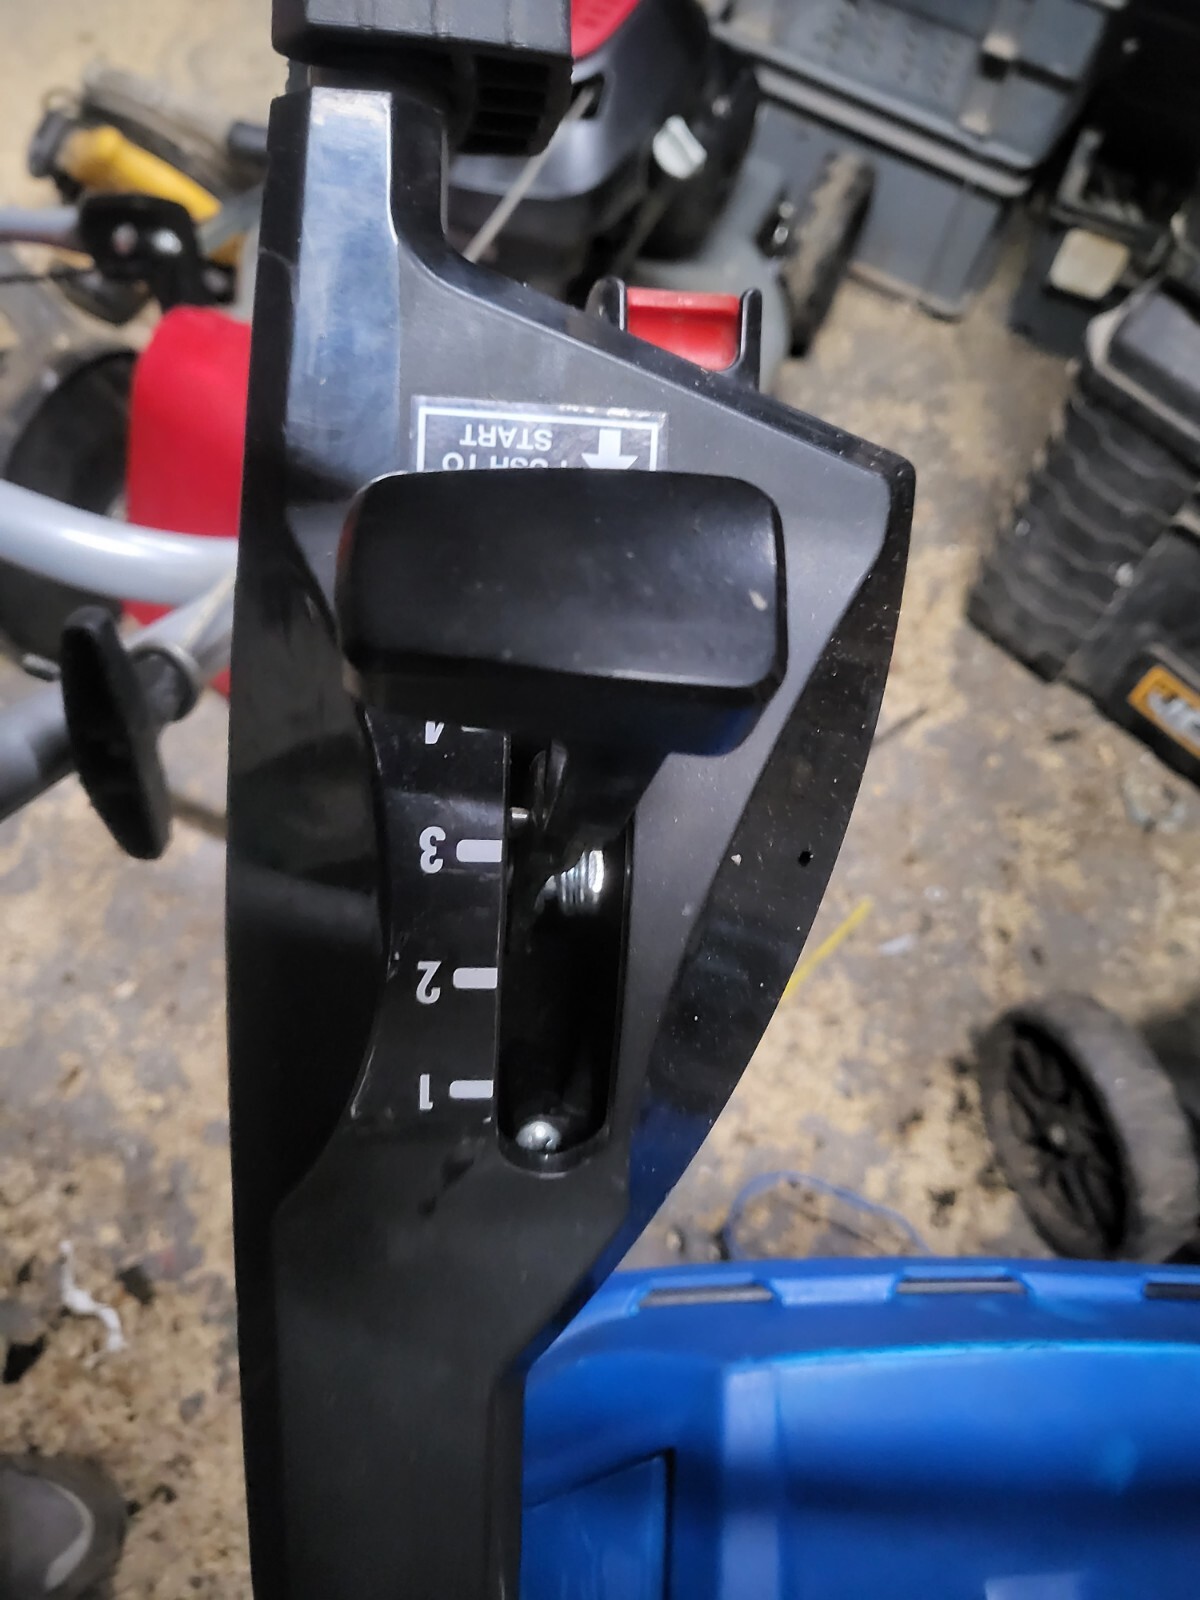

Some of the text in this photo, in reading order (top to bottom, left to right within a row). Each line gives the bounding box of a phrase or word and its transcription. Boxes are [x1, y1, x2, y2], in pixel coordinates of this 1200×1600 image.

[459, 423, 553, 451] START
[442, 452, 476, 472] TO
[418, 825, 447, 874] 3
[415, 960, 442, 1005] 2
[419, 1073, 434, 1111] 1
